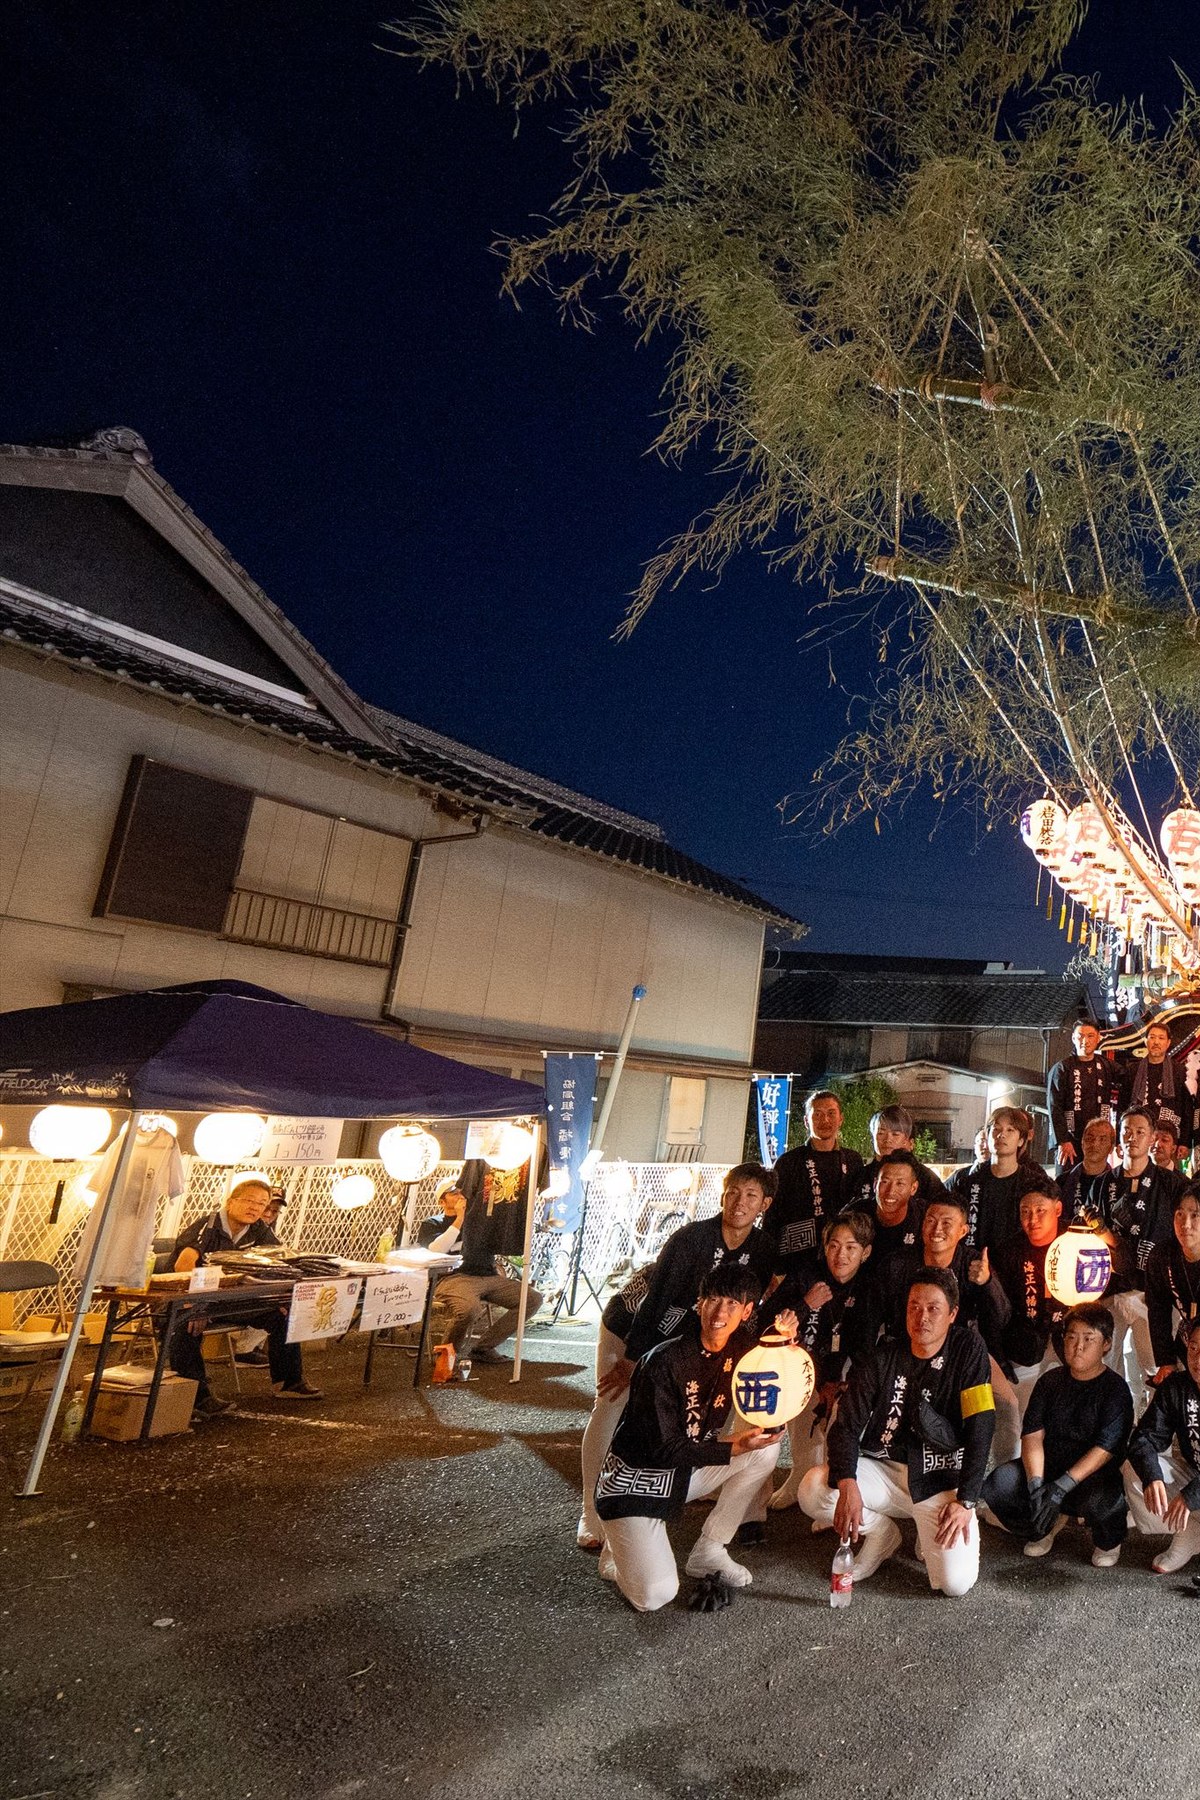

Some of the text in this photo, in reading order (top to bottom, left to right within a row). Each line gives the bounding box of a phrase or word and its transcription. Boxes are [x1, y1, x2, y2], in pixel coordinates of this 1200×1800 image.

[1167, 812, 1200, 857] 若
[1075, 1247, 1111, 1294] 西
[735, 1370, 782, 1416] 西
